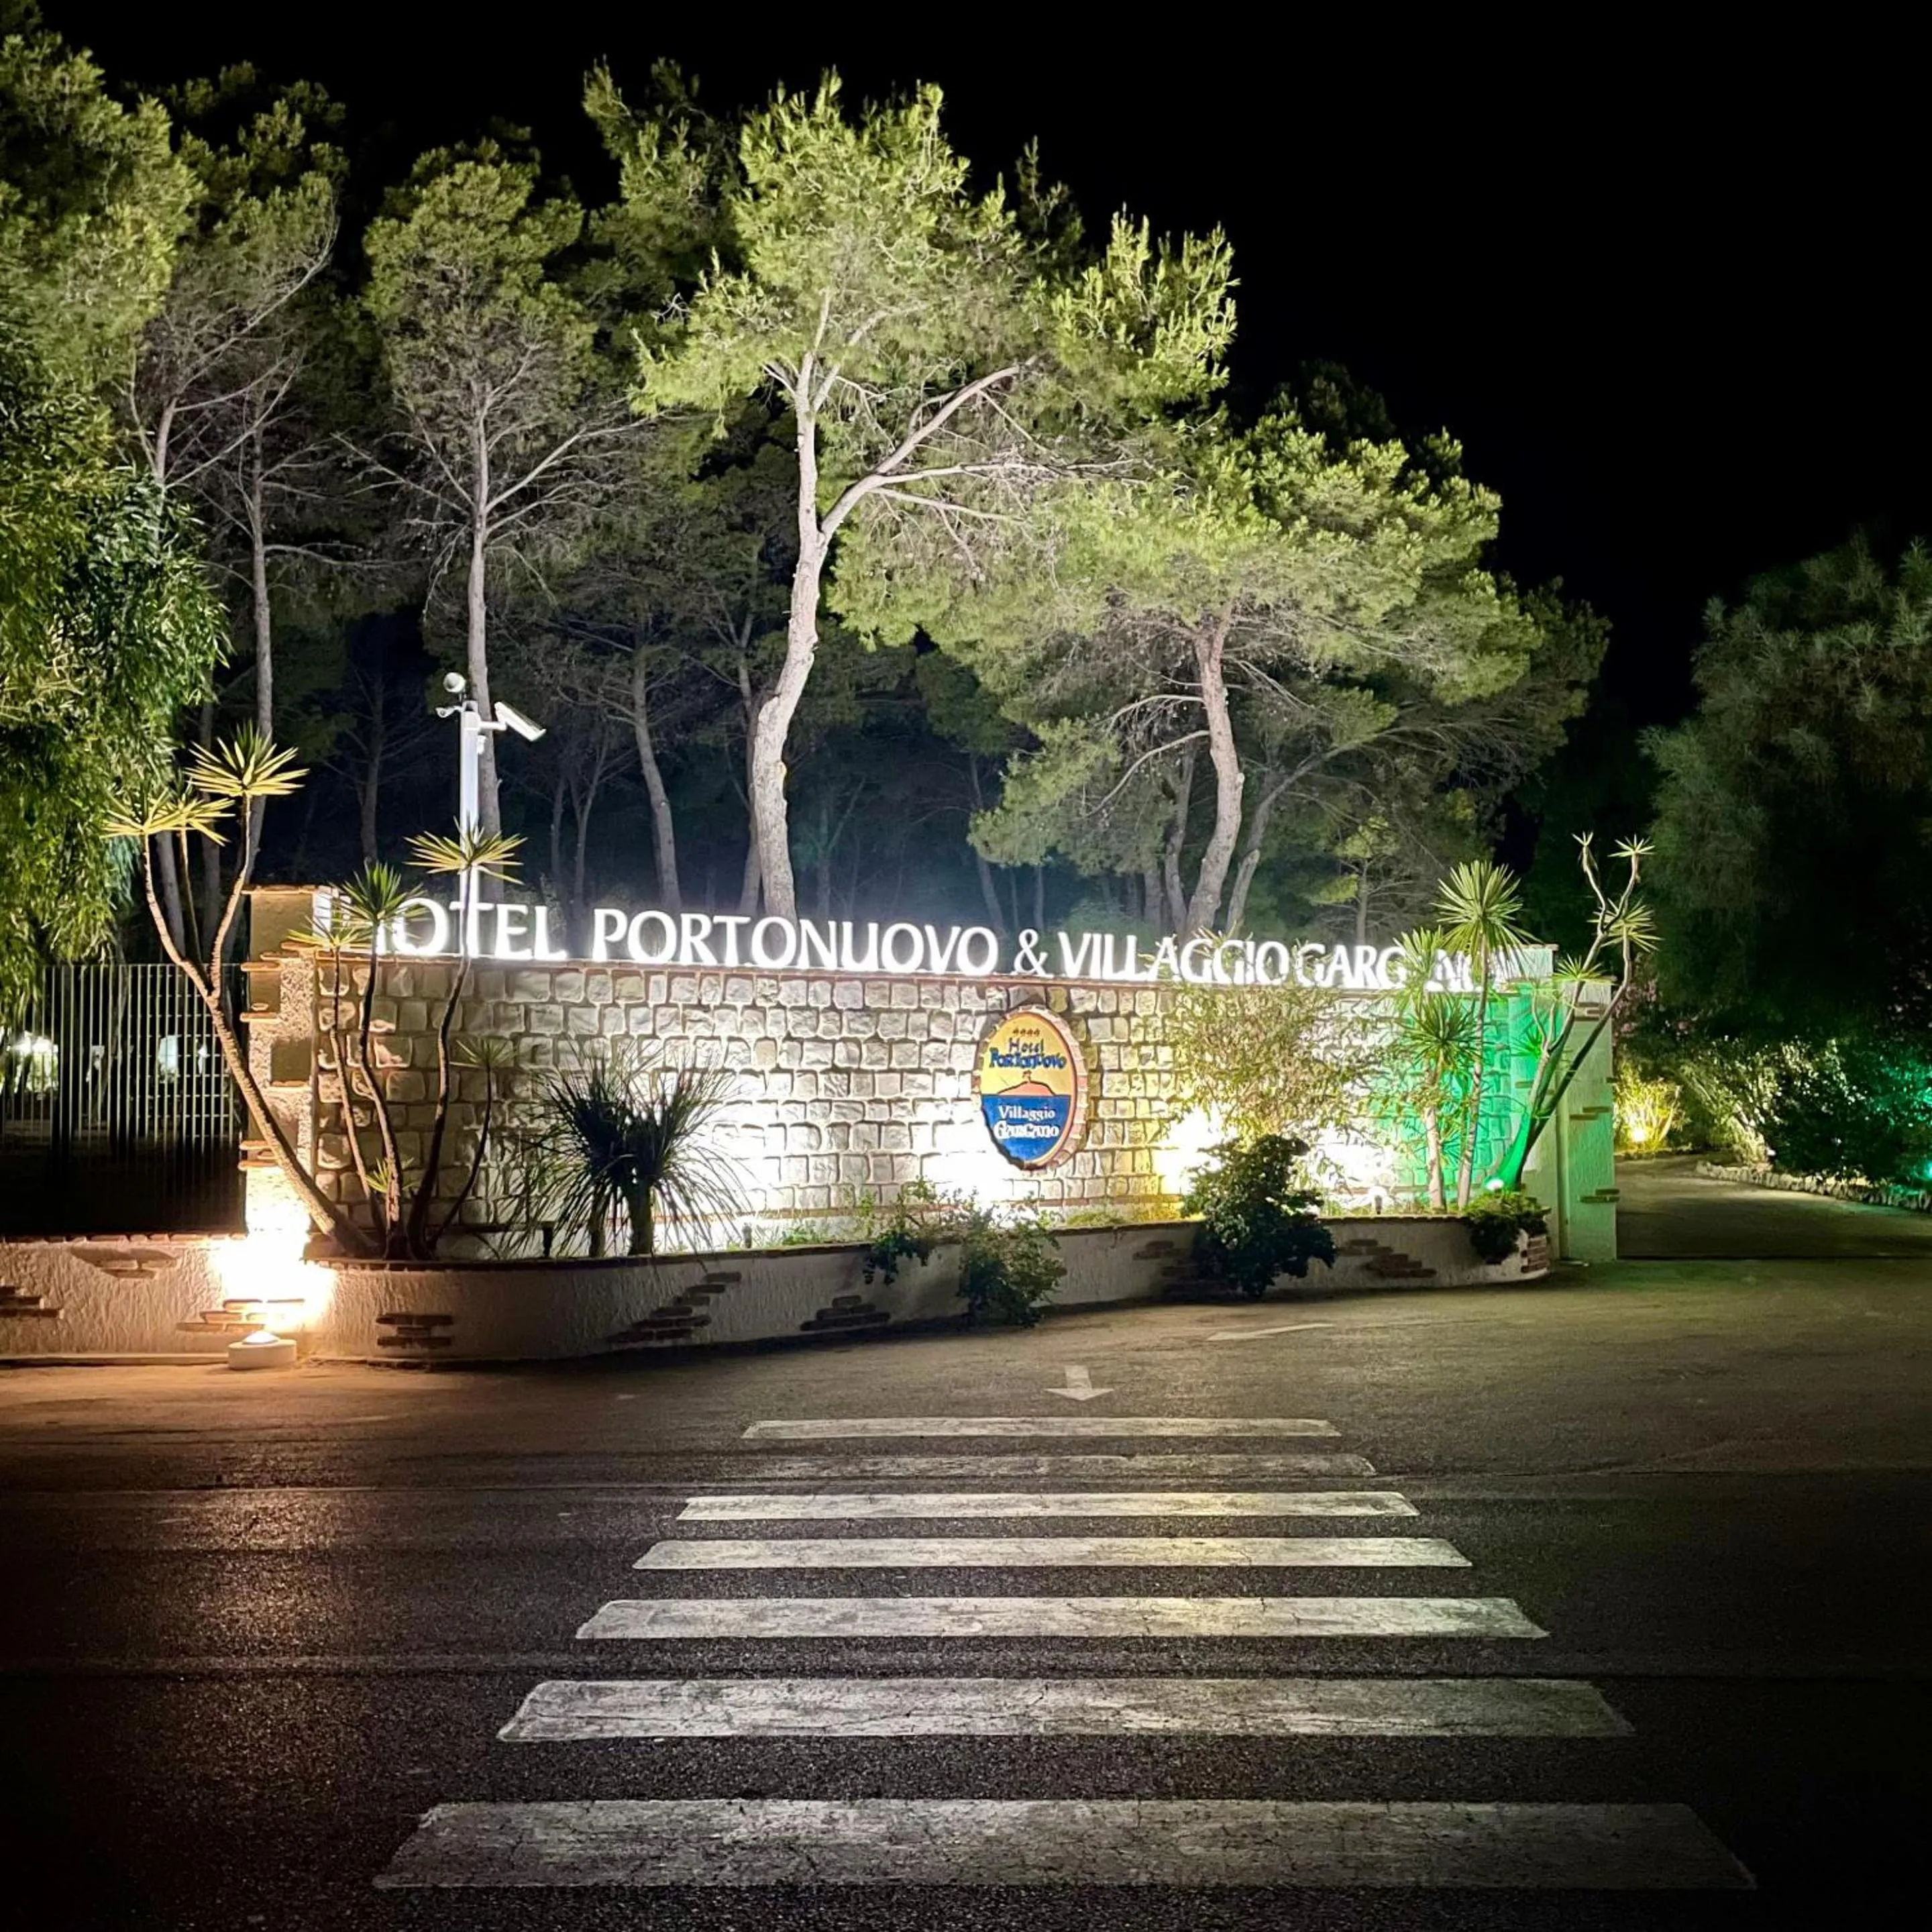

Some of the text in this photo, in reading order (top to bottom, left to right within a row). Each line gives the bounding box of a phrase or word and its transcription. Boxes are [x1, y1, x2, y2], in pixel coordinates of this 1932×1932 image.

[592, 908, 1000, 976] PORTONUOVO
[1014, 928, 1054, 978] &
[1057, 931, 1289, 985] VILLAGGIO
[1295, 942, 1506, 992] GARGN
[998, 1105, 1056, 1122] Villaggio
